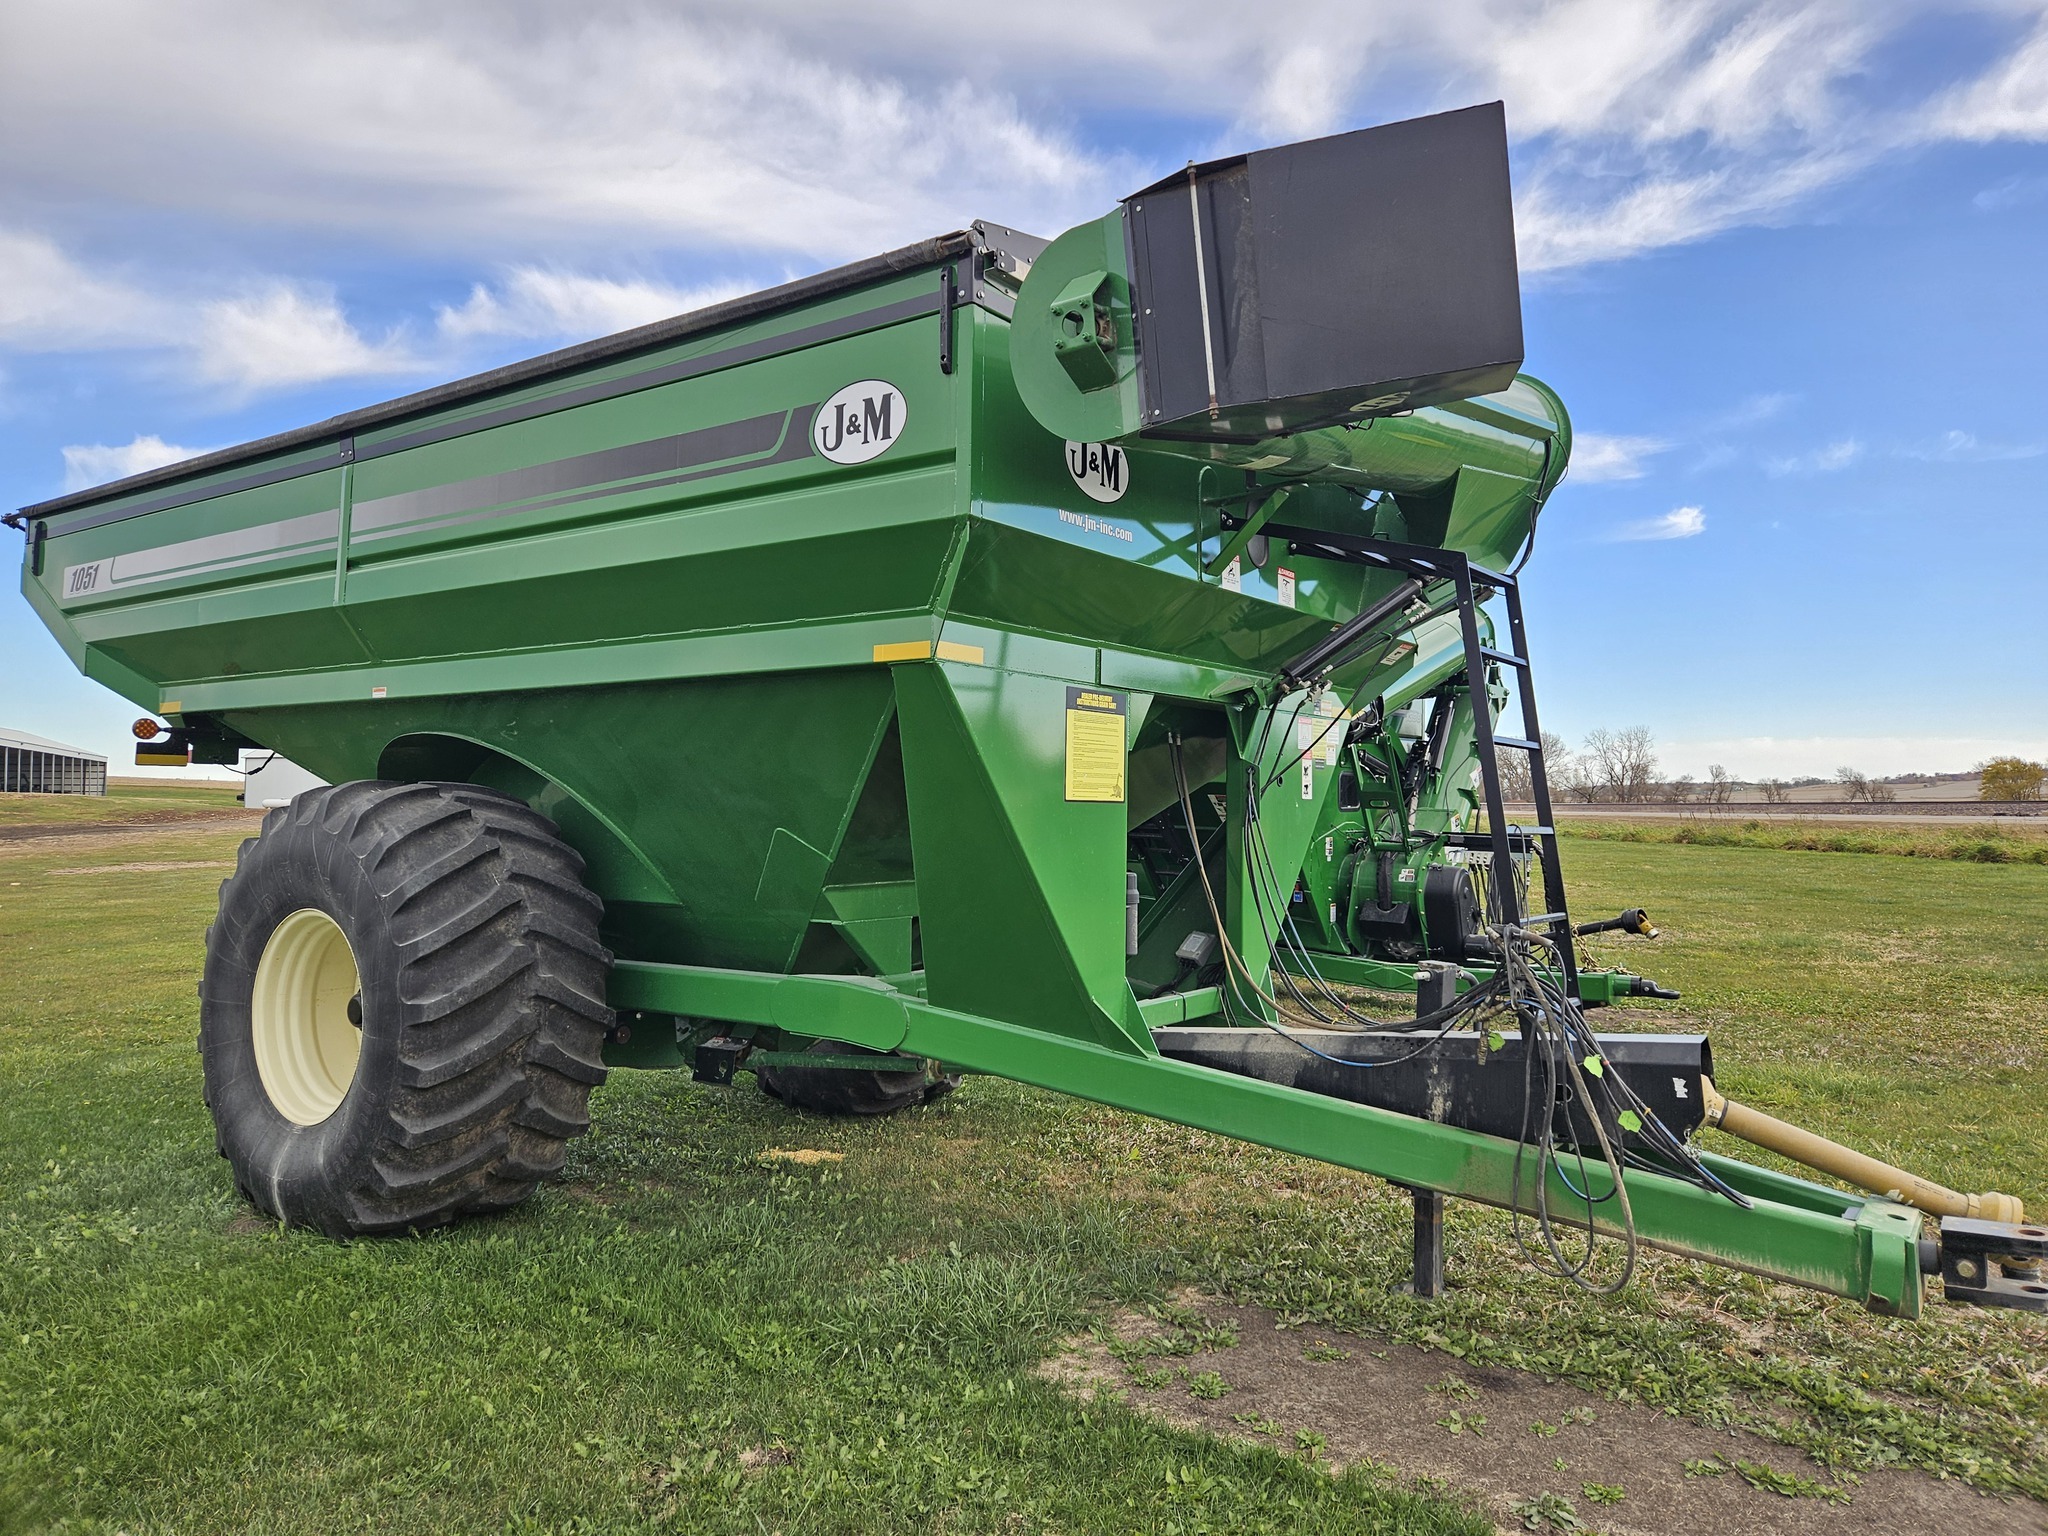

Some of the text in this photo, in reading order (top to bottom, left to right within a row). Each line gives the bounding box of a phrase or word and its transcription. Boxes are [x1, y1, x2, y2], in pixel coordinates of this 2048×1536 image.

[821, 392, 893, 452] J&M
[1070, 443, 1121, 493] J&M
[1059, 508, 1133, 542] www.jm-inc.com
[70, 563, 100, 592] 1051
